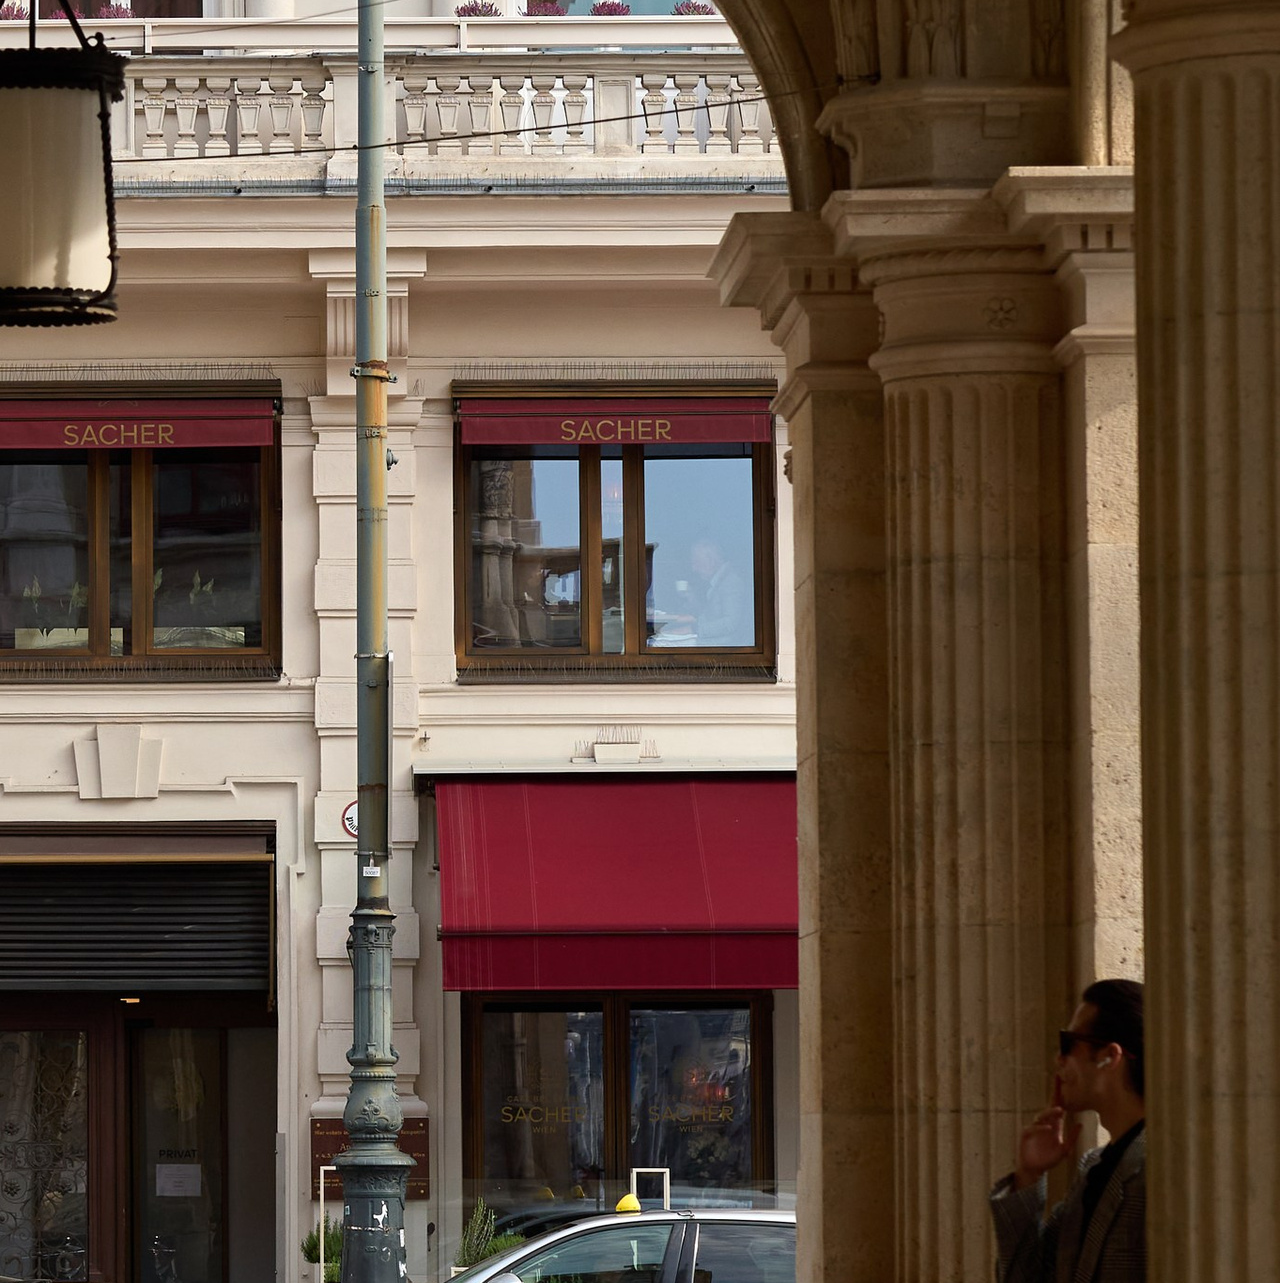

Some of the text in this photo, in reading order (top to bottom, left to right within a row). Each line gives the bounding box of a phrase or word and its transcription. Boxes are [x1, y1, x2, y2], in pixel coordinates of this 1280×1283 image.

[63, 423, 175, 446] SACHER
[560, 419, 672, 441] SACHER
[501, 1106, 588, 1123] SACHER
[648, 1105, 735, 1122] SACHER
[532, 1126, 557, 1134] WIEN
[679, 1125, 703, 1133] WIEN
[158, 1149, 198, 1159] PRIVAT
